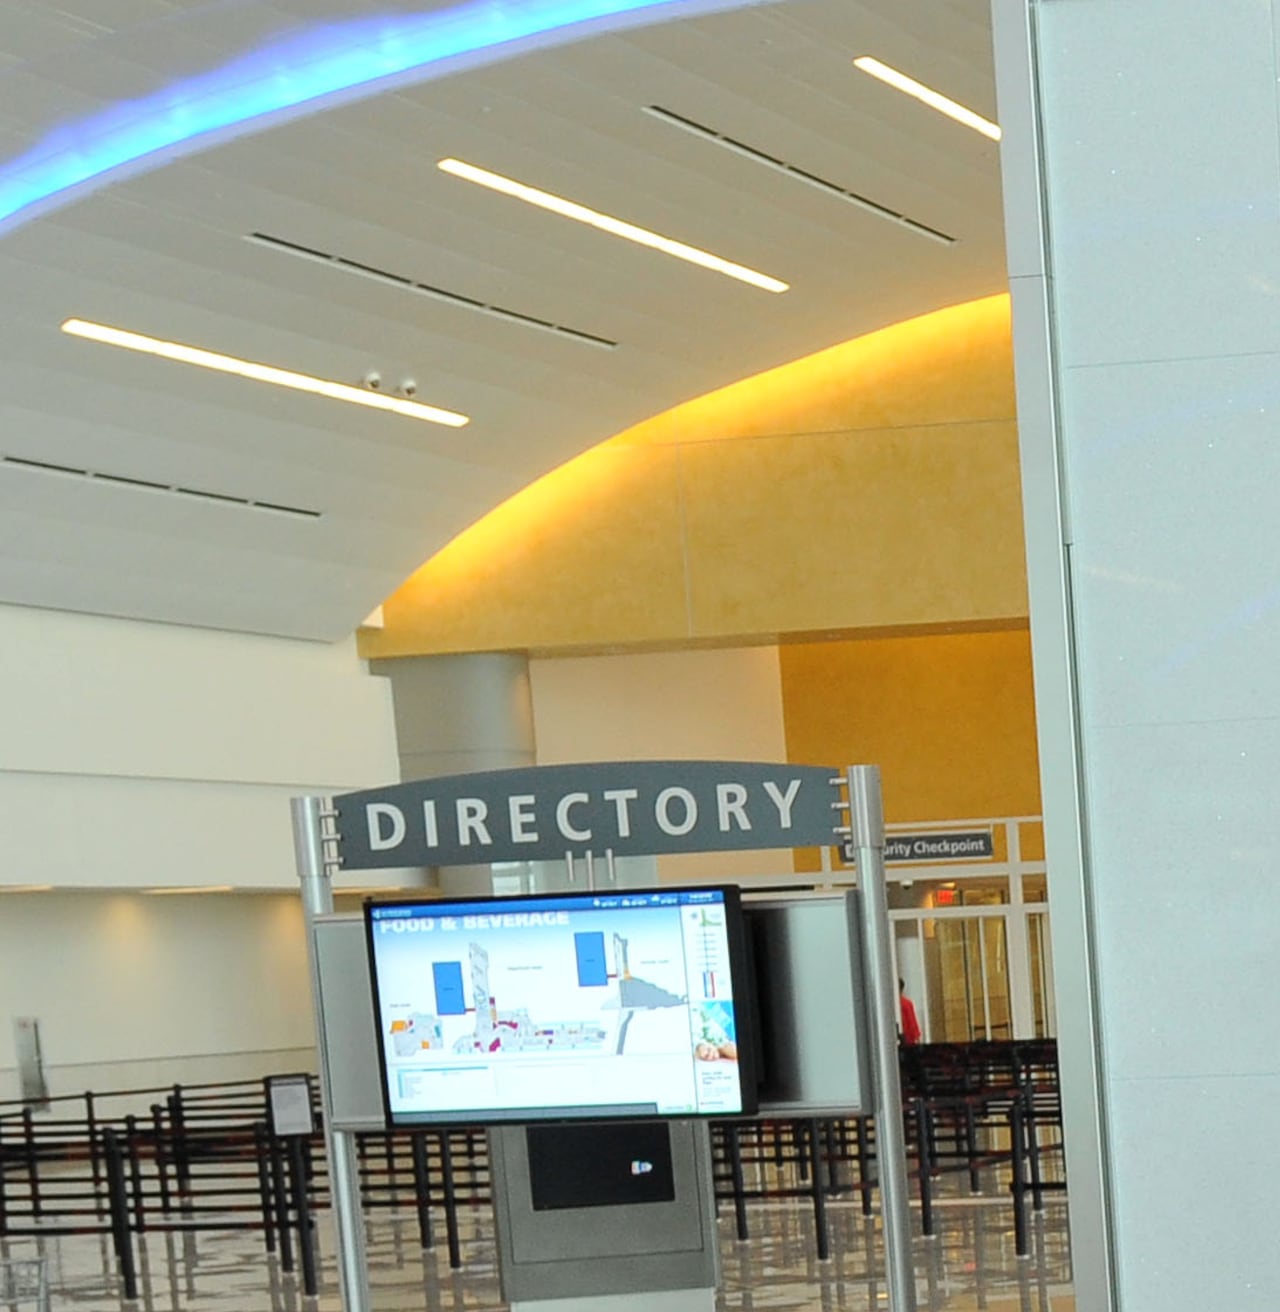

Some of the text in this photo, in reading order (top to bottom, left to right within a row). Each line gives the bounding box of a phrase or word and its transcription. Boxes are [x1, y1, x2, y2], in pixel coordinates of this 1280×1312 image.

[366, 779, 803, 852] DIRECTORY
[883, 839, 985, 857] urity Checkpoint
[380, 910, 570, 934] FOOD & BEVERAGE
